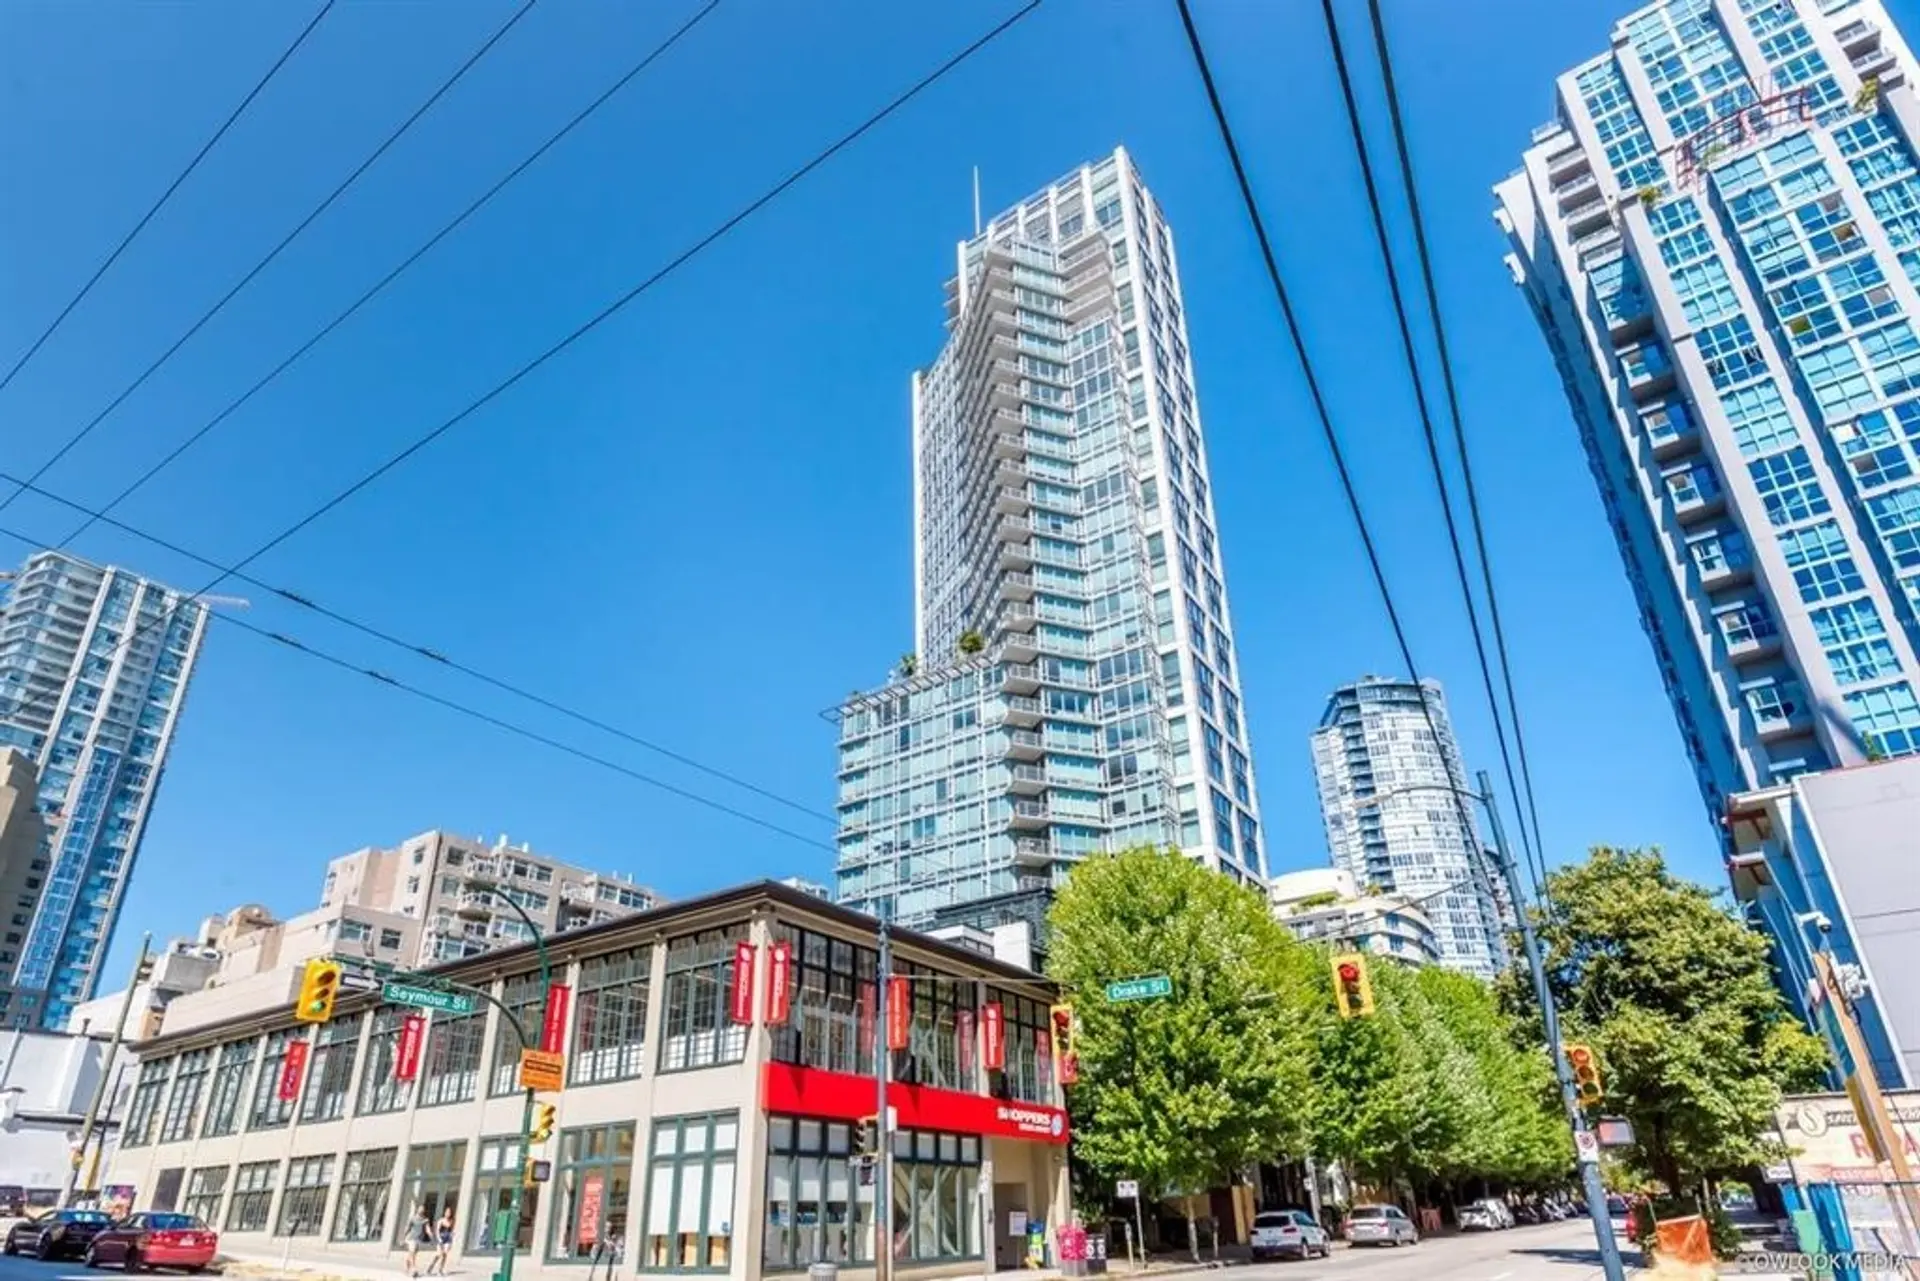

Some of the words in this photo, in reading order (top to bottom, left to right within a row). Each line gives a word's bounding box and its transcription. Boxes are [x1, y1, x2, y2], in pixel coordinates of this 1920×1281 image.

[390, 985, 448, 1006] Seymour
[452, 995, 467, 1010] St
[1151, 981, 1164, 995] St
[997, 1106, 1050, 1125] SHOPPERS
